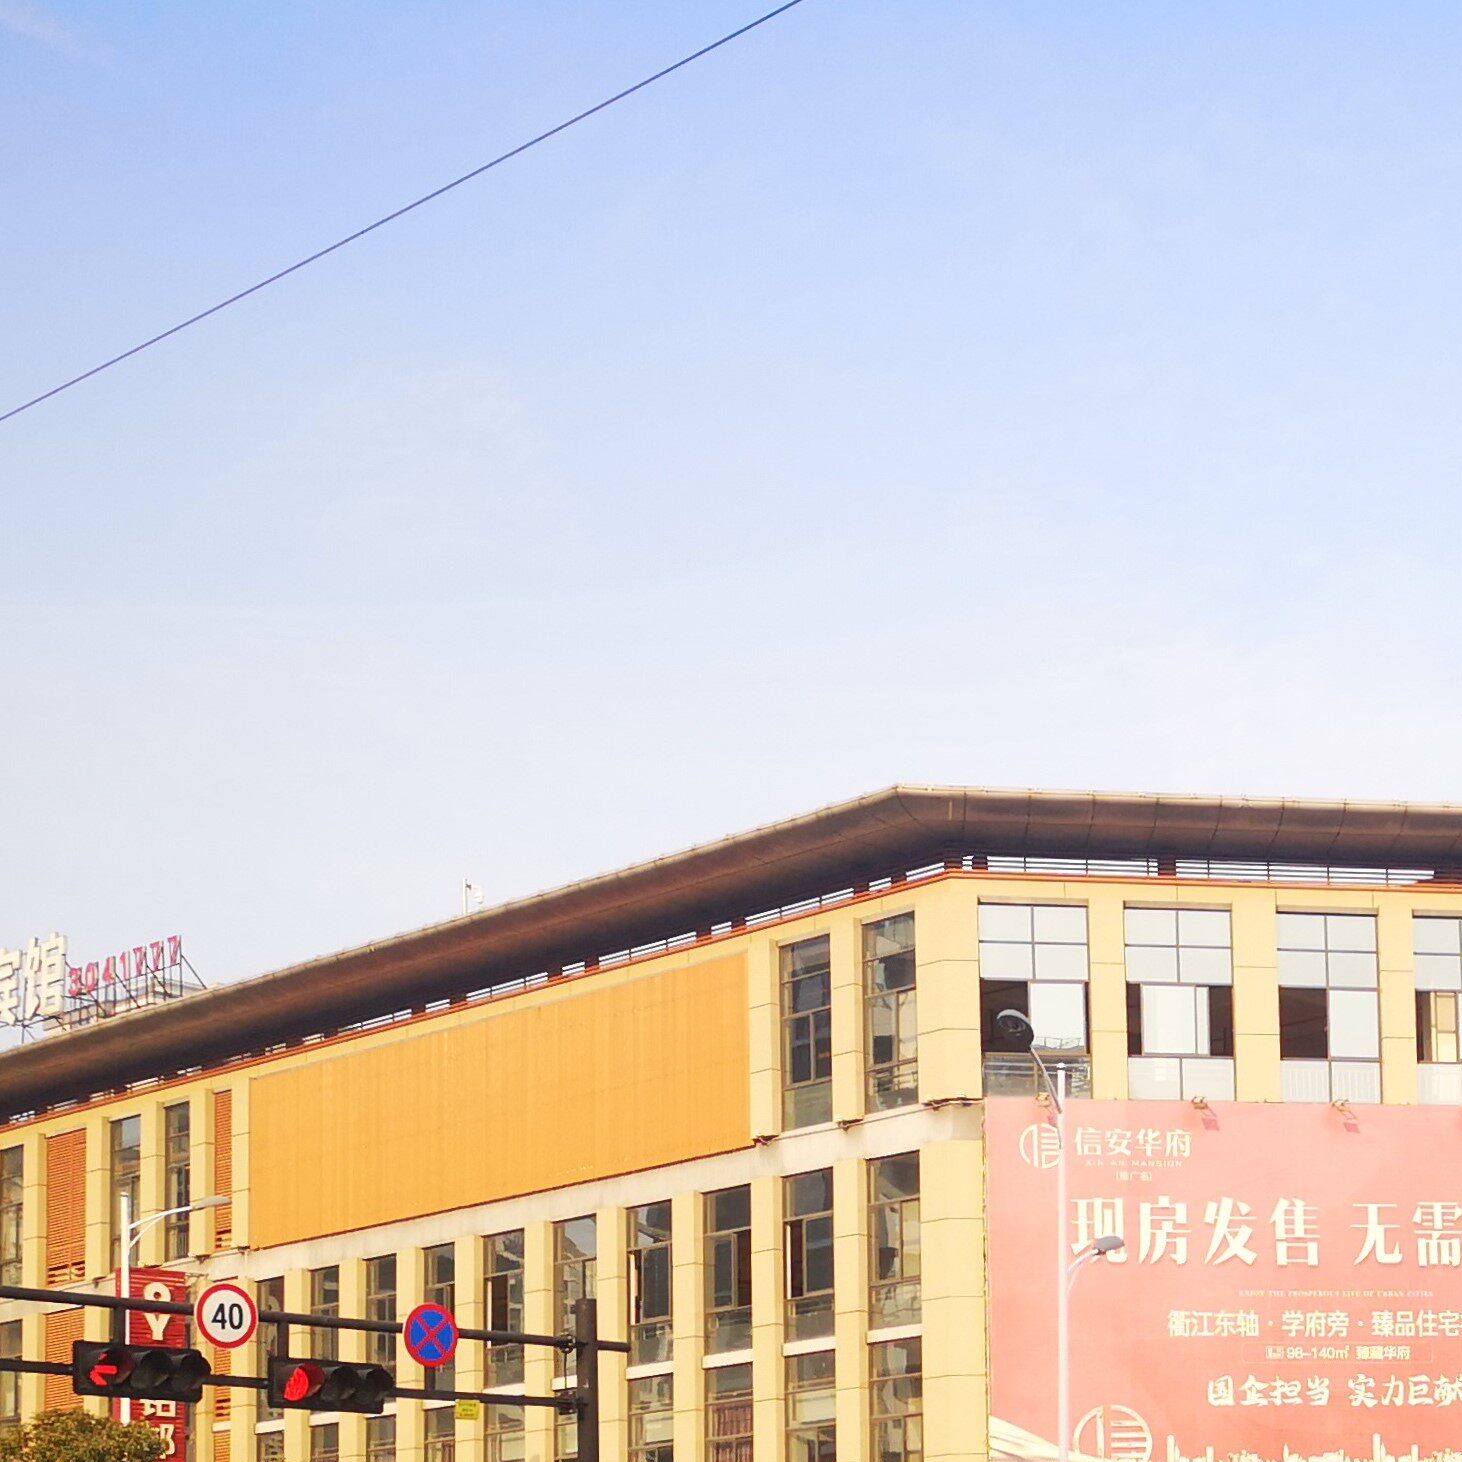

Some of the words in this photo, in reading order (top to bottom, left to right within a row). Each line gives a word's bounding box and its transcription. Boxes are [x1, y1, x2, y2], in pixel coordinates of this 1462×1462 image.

[68, 935, 181, 998] 3041777
[1074, 1127, 1193, 1157] 信安华府
[1110, 1160, 1127, 1168] AN
[1131, 1160, 1183, 1168] MANSION
[1070, 1196, 1321, 1266] 现房发售
[211, 1303, 244, 1330] 40
[1207, 1374, 1331, 1407] 国企担当
